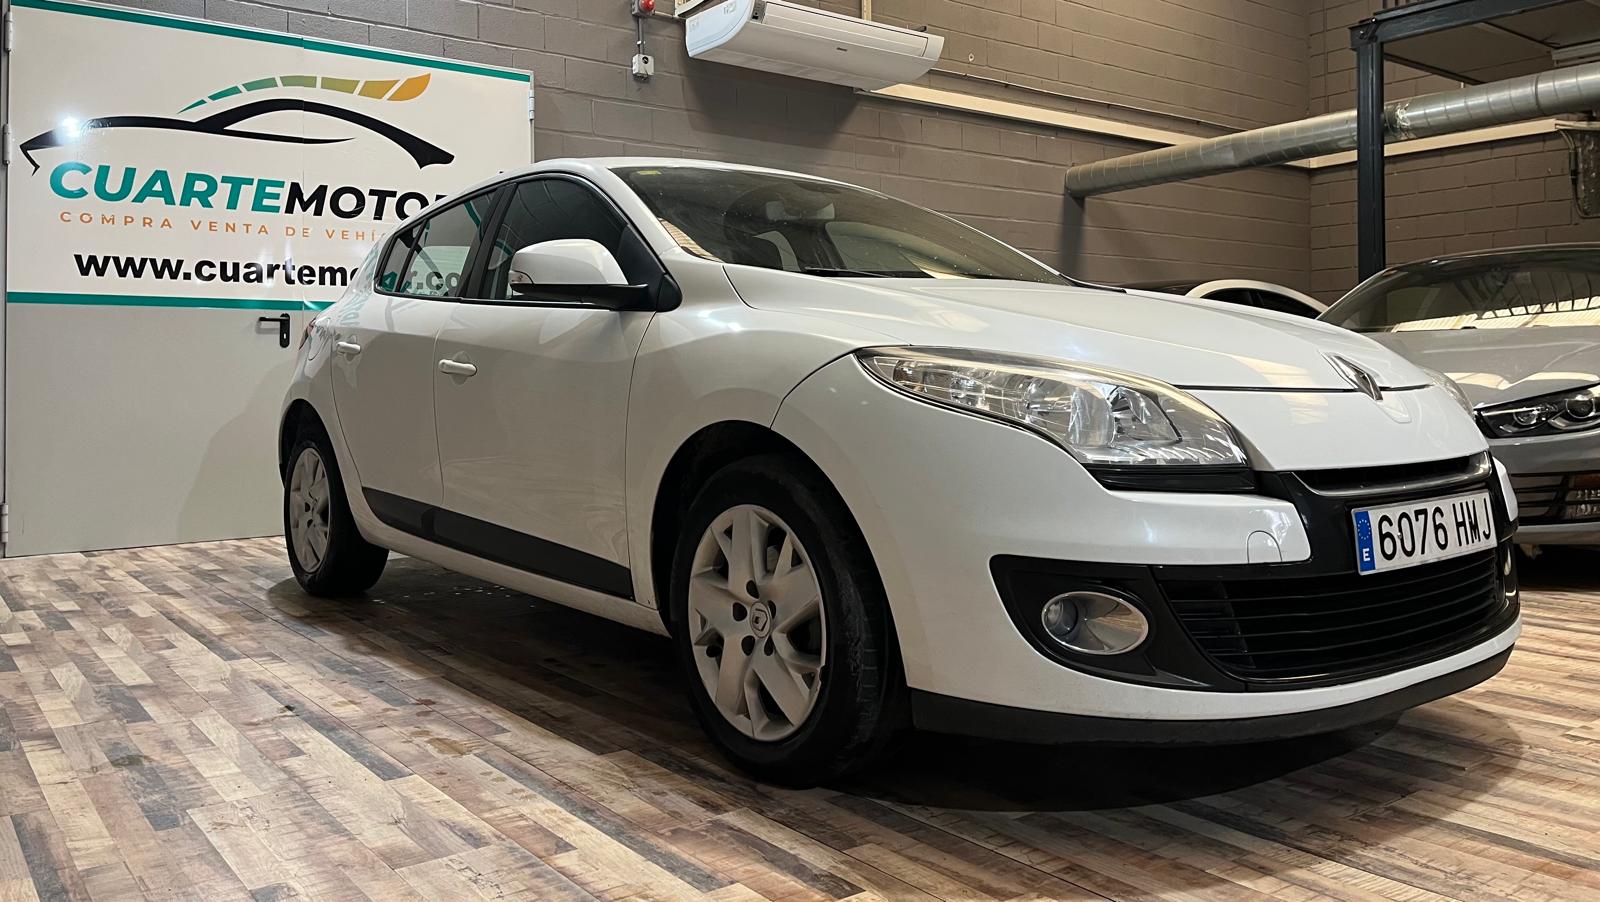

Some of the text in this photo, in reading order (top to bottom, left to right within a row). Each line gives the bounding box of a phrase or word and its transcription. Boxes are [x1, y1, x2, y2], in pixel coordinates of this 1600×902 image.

[50, 161, 448, 221] CUARTEMOTO
[60, 211, 386, 242] COMPRA VENTA DE VEHÍ
[1377, 497, 1491, 561] 6076 HMJ
[1363, 548, 1371, 561] E
